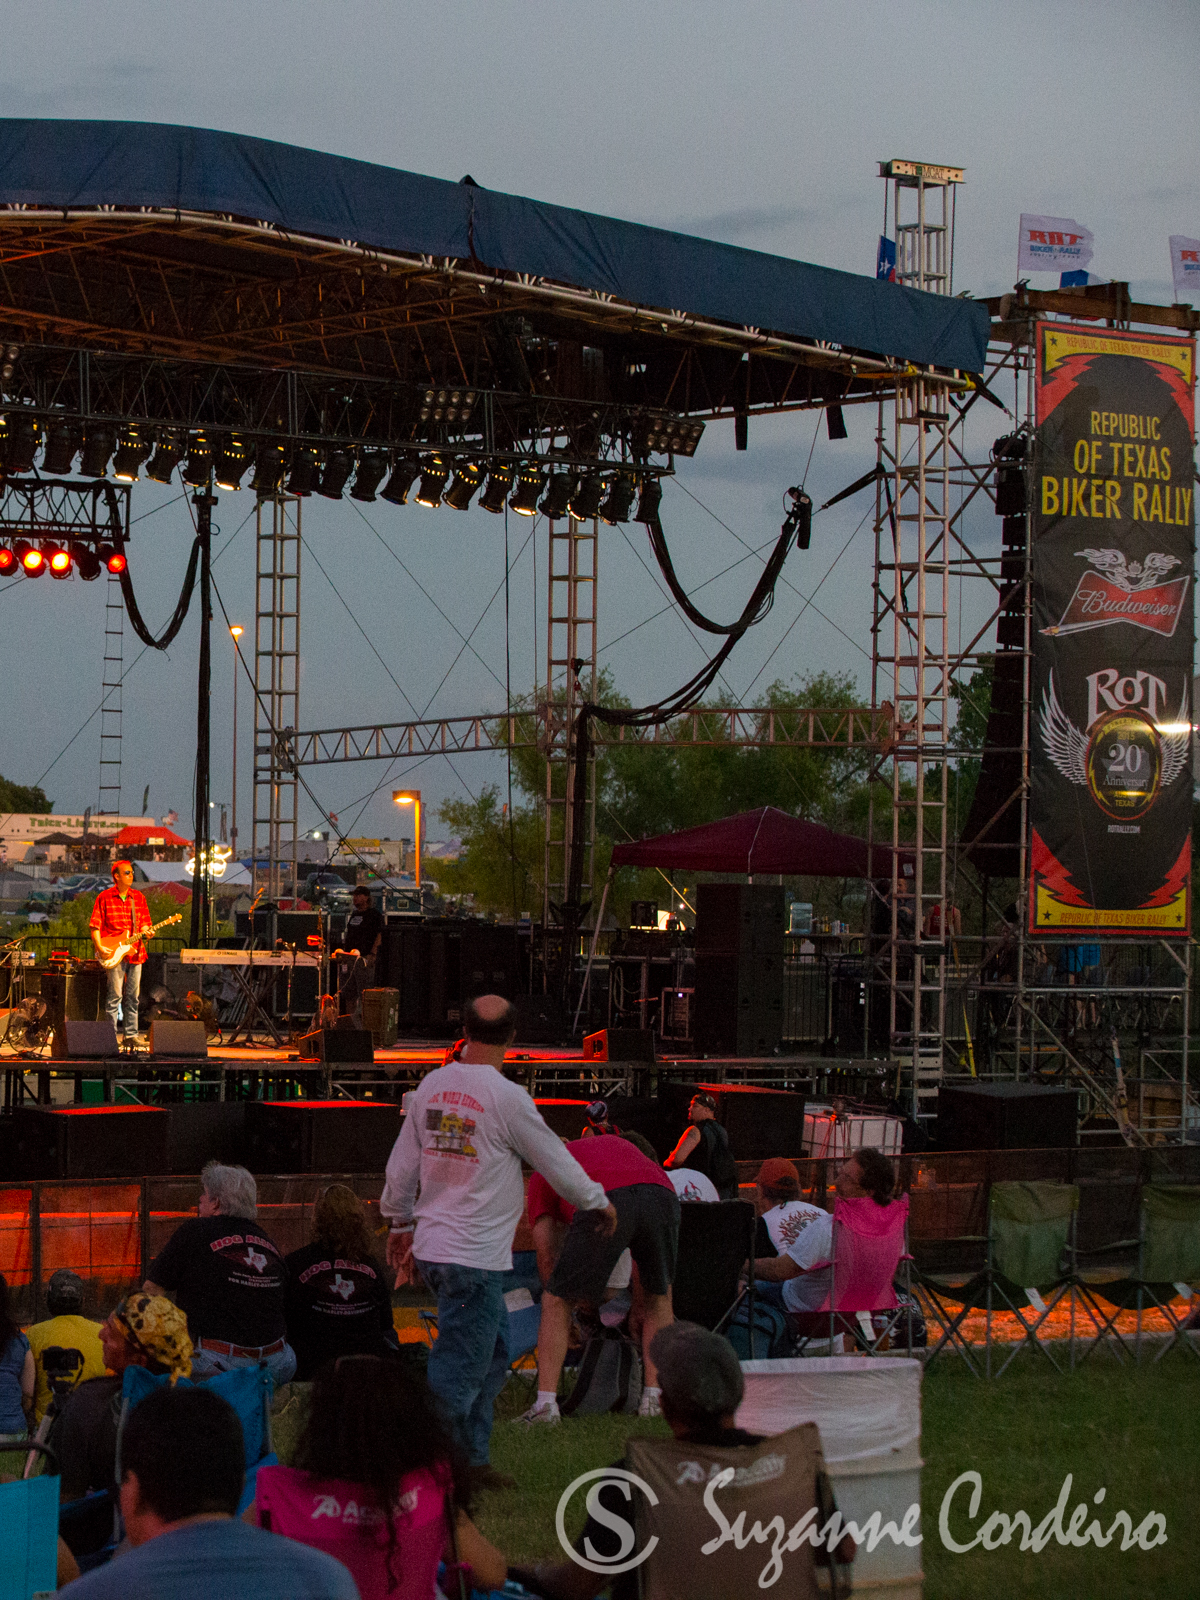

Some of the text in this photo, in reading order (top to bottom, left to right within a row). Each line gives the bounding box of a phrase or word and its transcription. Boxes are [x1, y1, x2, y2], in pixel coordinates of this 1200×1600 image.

[1090, 410, 1162, 440] REPUBLIC
[1073, 439, 1172, 481] OF TEXAS
[1041, 475, 1193, 526] BIKER RALLY
[1076, 589, 1177, 616] Budweiser
[1085, 668, 1167, 733] ROT
[1108, 743, 1142, 773] 20
[1103, 774, 1148, 788] Anniversary
[1115, 799, 1135, 807] TEXAS
[1060, 912, 1092, 924] REPUBLIC
[1103, 913, 1123, 924] TEXAS
[1125, 913, 1146, 925] BIKER
[1147, 914, 1167, 925] RALLY
[209, 1234, 244, 1253] HOG
[299, 1260, 332, 1284] HOG
